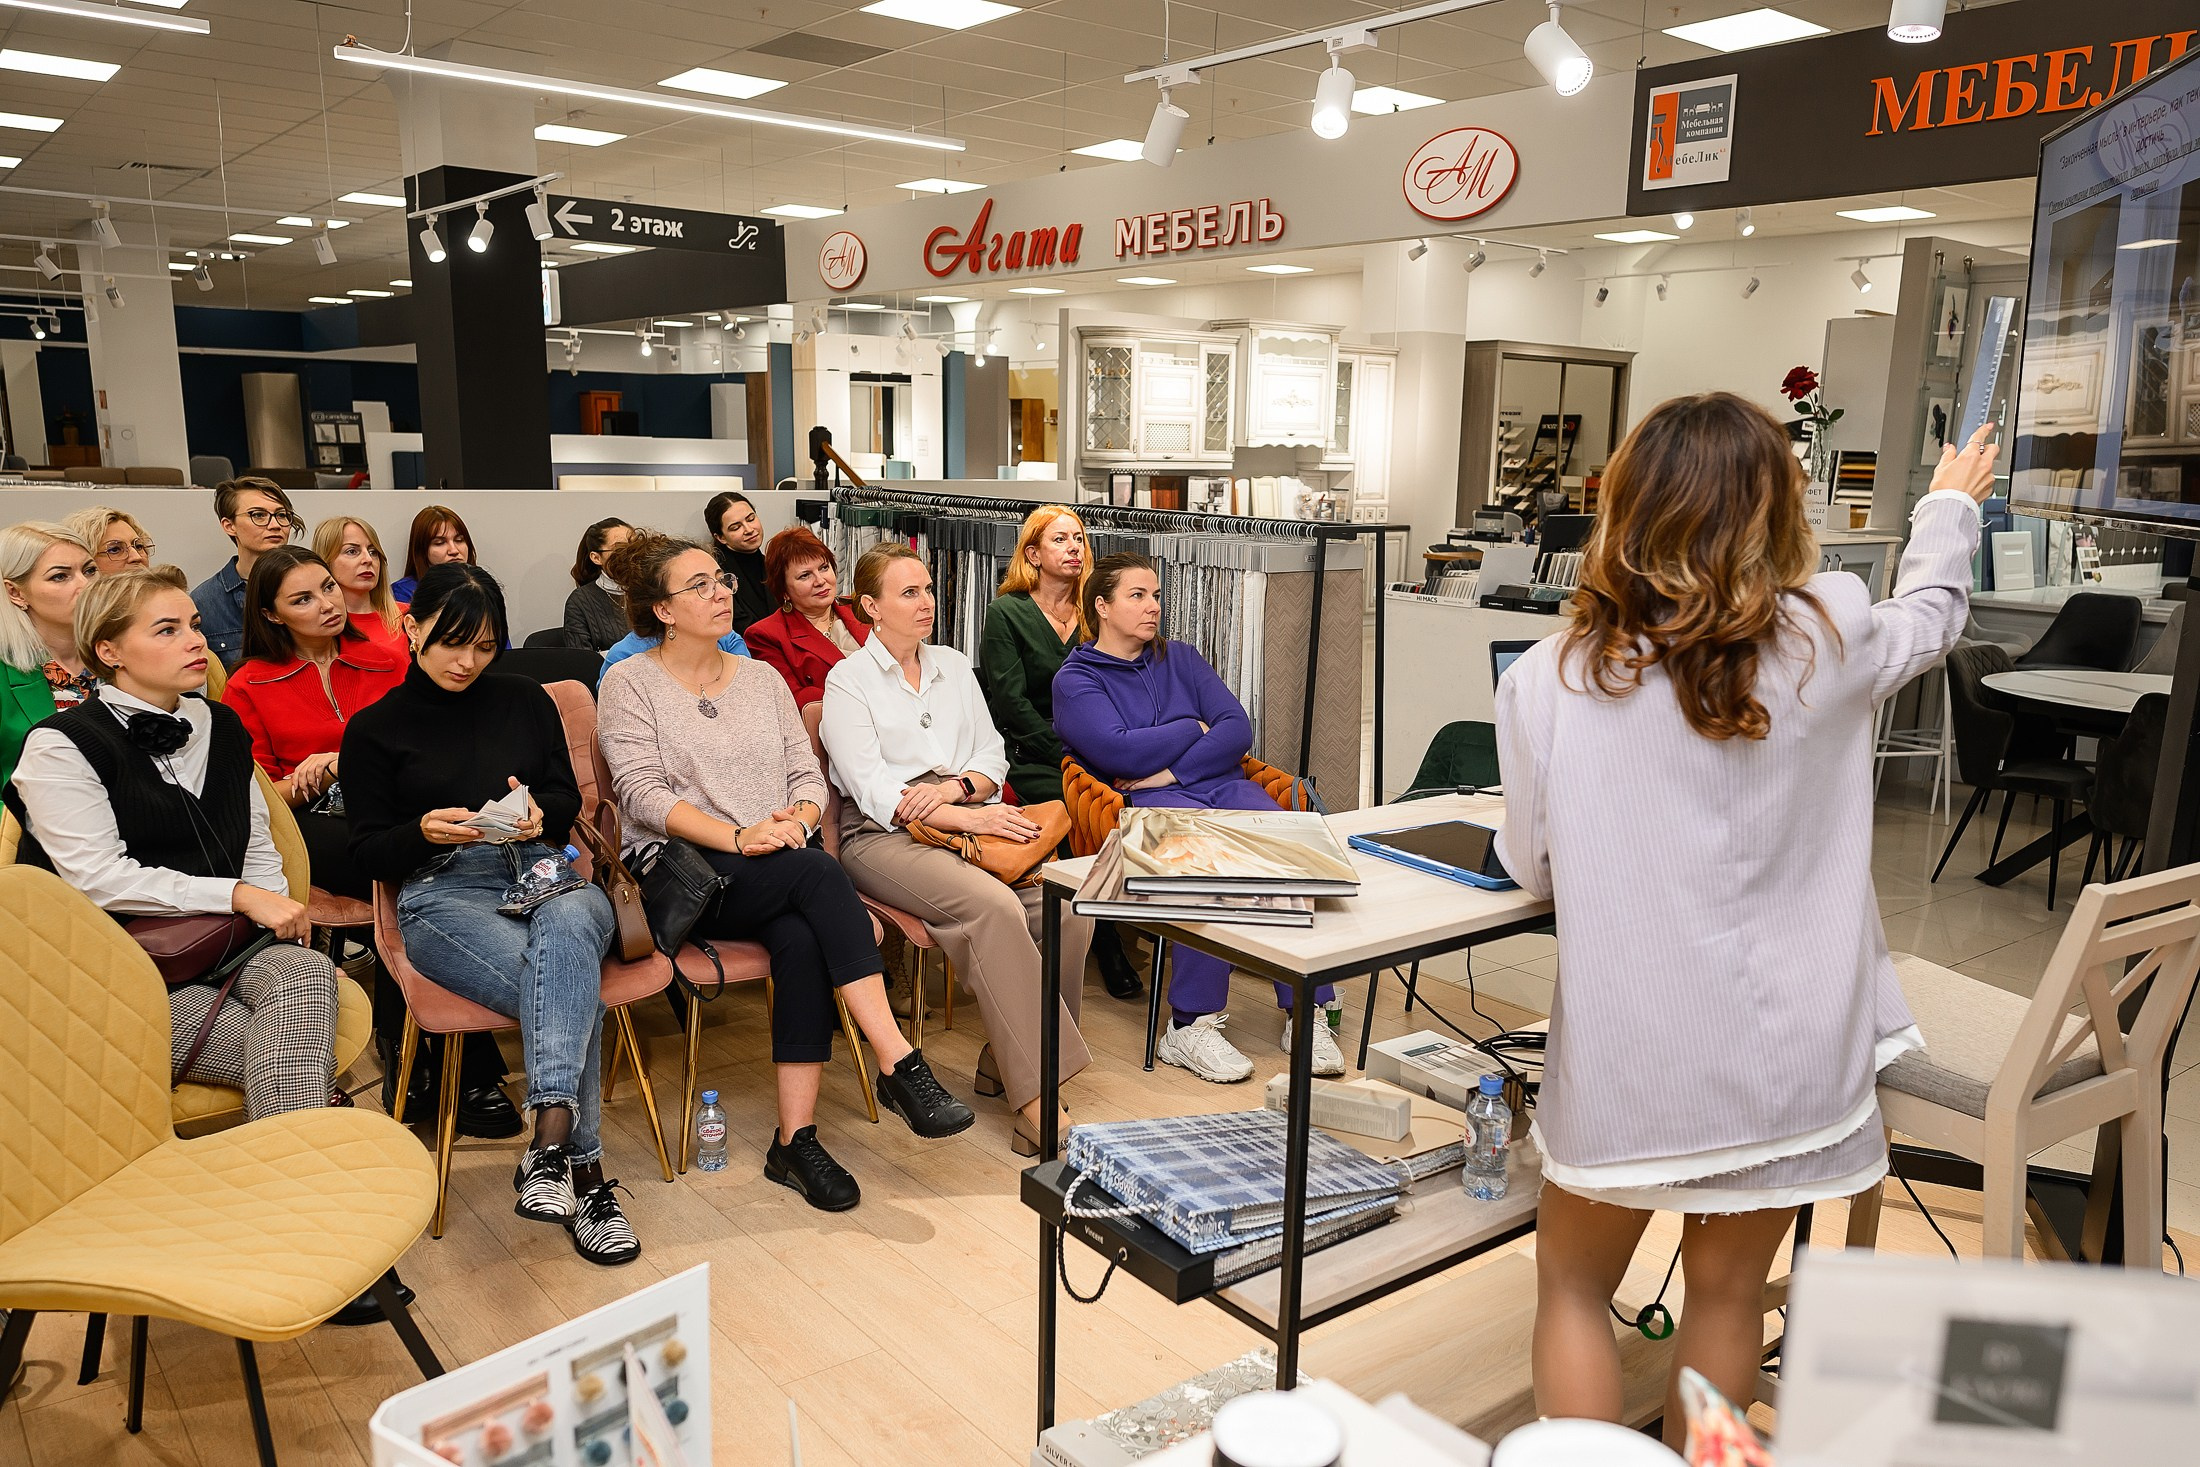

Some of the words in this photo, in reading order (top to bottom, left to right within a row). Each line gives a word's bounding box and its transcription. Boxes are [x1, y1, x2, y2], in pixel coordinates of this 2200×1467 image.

[1681, 116, 1724, 130] Мебельная
[1686, 126, 1723, 138] компания
[611, 208, 625, 232] 2
[630, 215, 684, 239] этаж
[923, 198, 1082, 277] Агата
[1114, 198, 1286, 258] МЕБЕЛЬ
[1084, 1225, 1104, 1245] Vincent
